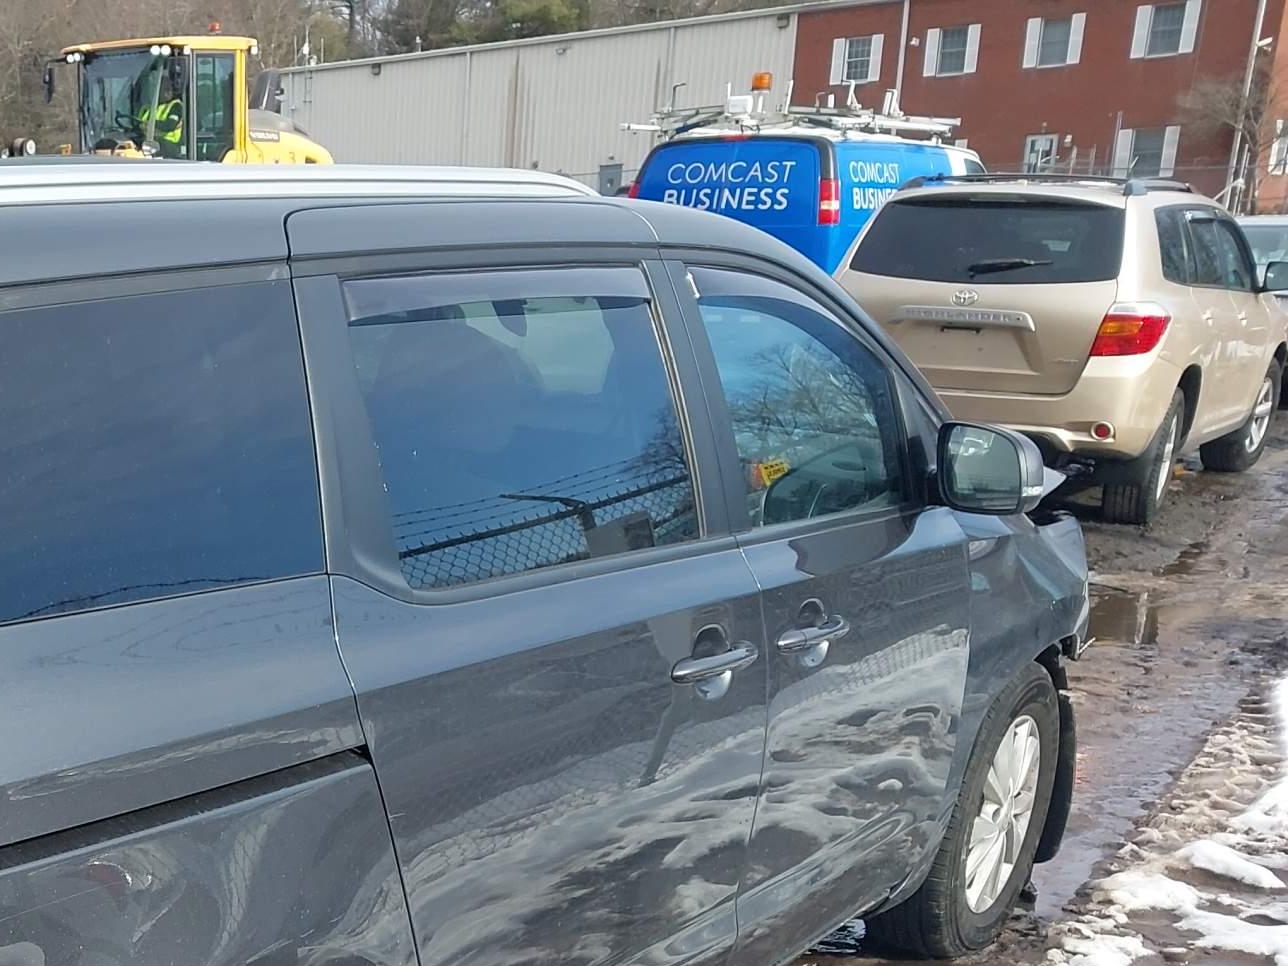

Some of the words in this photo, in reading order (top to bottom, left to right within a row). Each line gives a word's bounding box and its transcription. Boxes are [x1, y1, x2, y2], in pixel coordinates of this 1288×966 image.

[667, 160, 797, 184] COMCAST
[849, 161, 900, 184] COMCAST
[663, 187, 790, 210] BUSINESS
